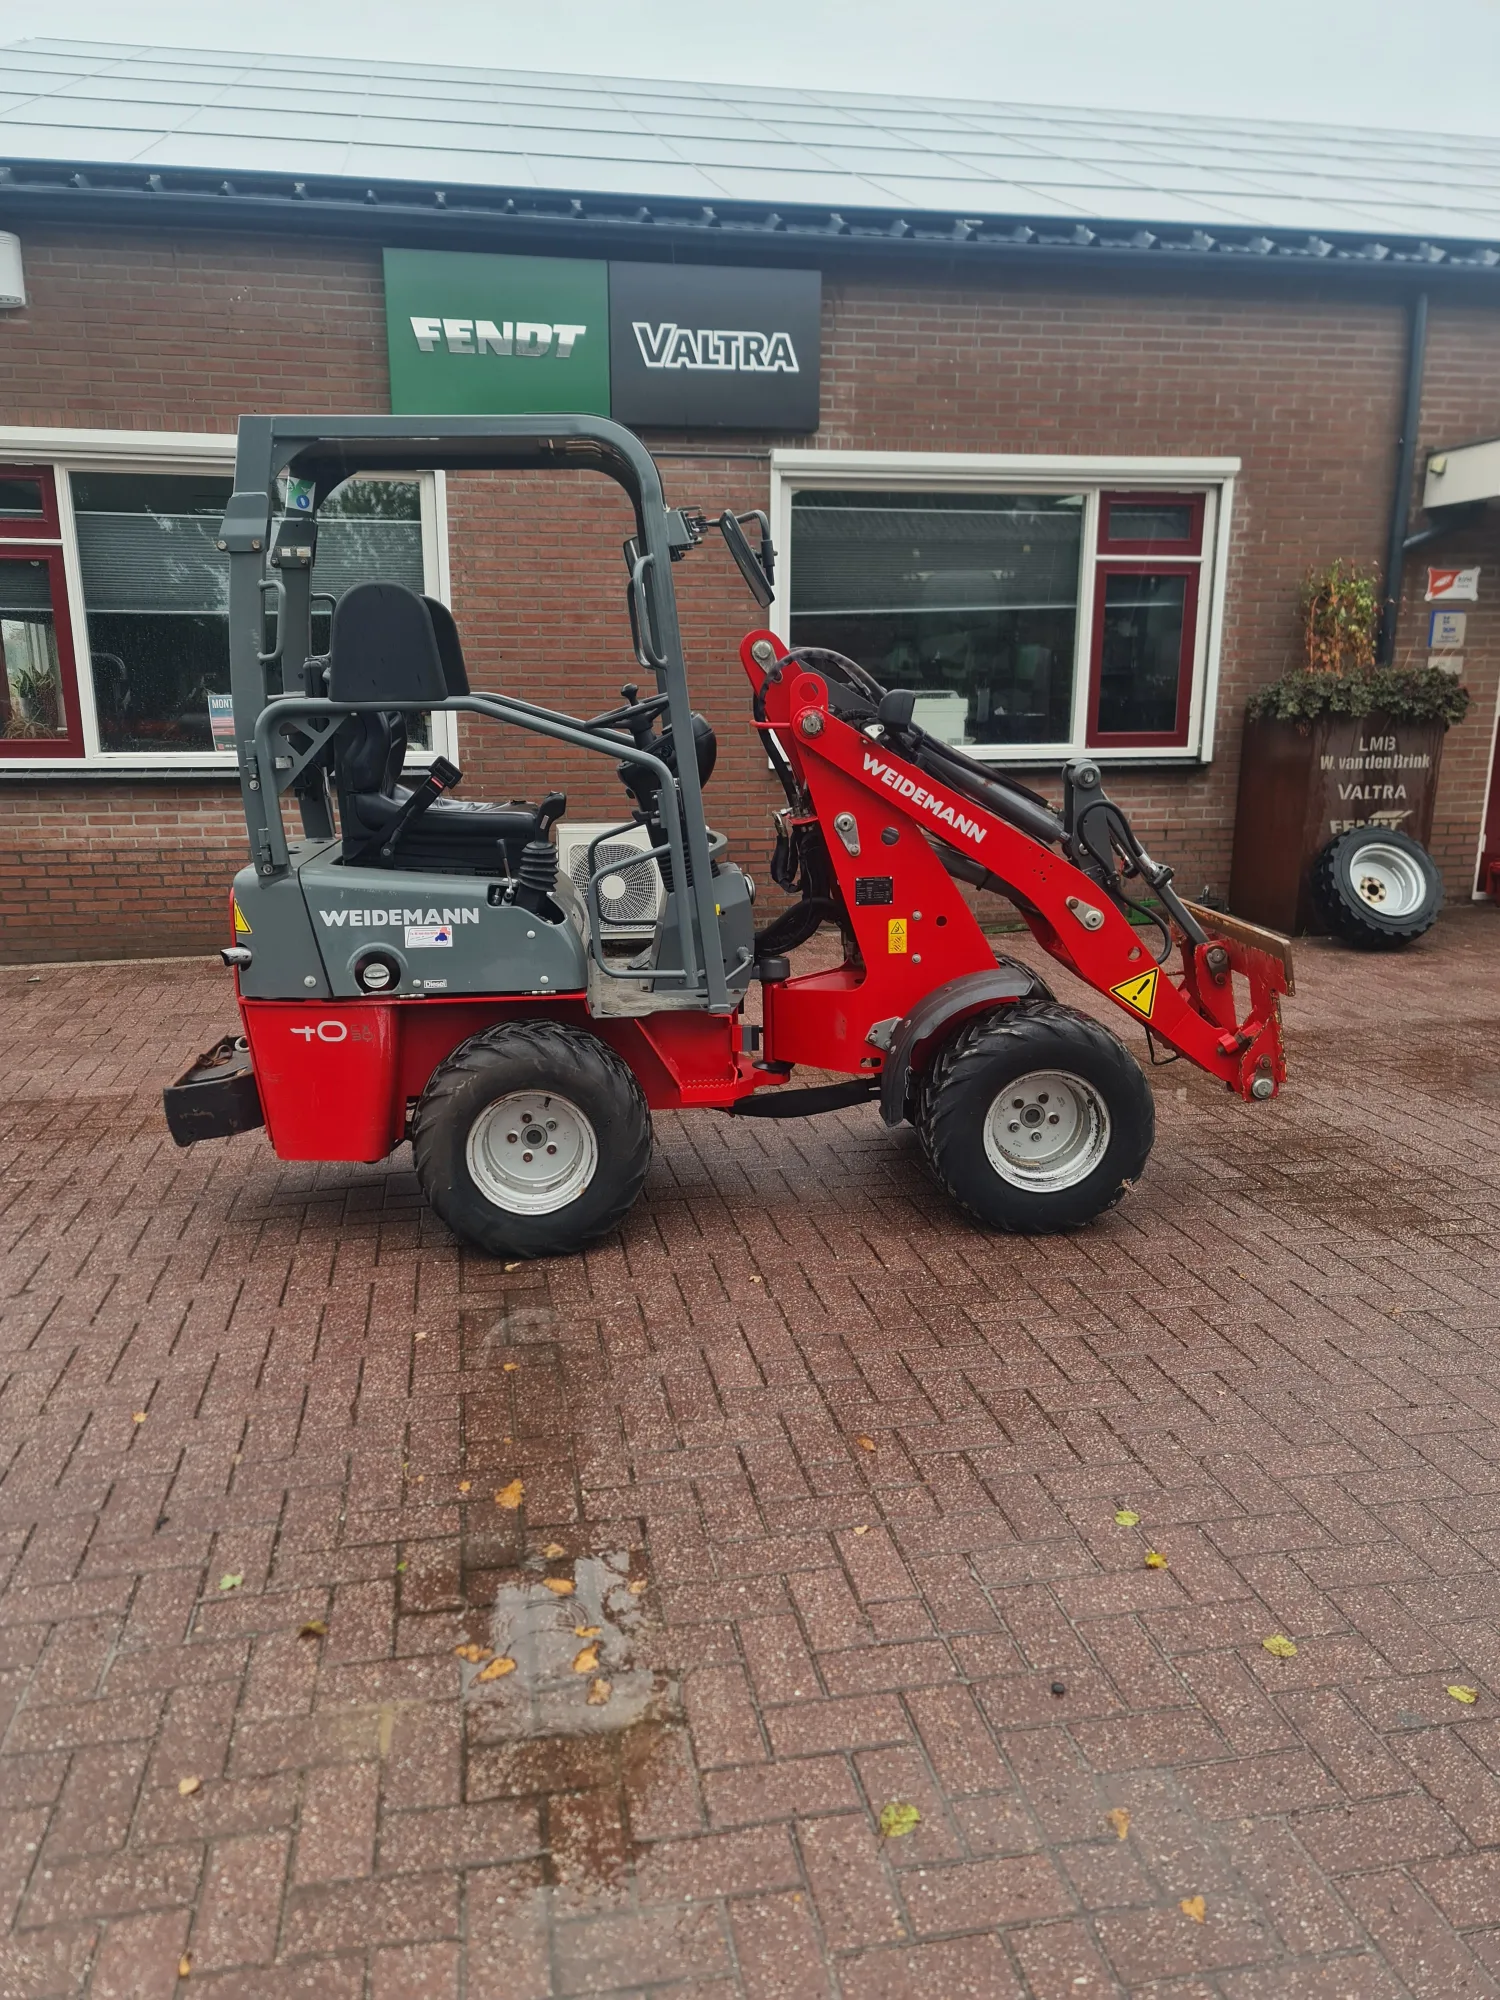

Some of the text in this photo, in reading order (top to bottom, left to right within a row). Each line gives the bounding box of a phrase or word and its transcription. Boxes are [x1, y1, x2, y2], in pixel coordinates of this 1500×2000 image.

[410, 317, 587, 358] FENDT
[632, 322, 799, 373] VALTRA
[1359, 736, 1396, 752] LMB
[1320, 753, 1431, 770] W. van den Brink
[863, 752, 987, 843] WEIDEMANN
[1338, 783, 1407, 800] VALTRA
[319, 907, 479, 927] WEIDEMANN
[424, 980, 446, 988] Diesel
